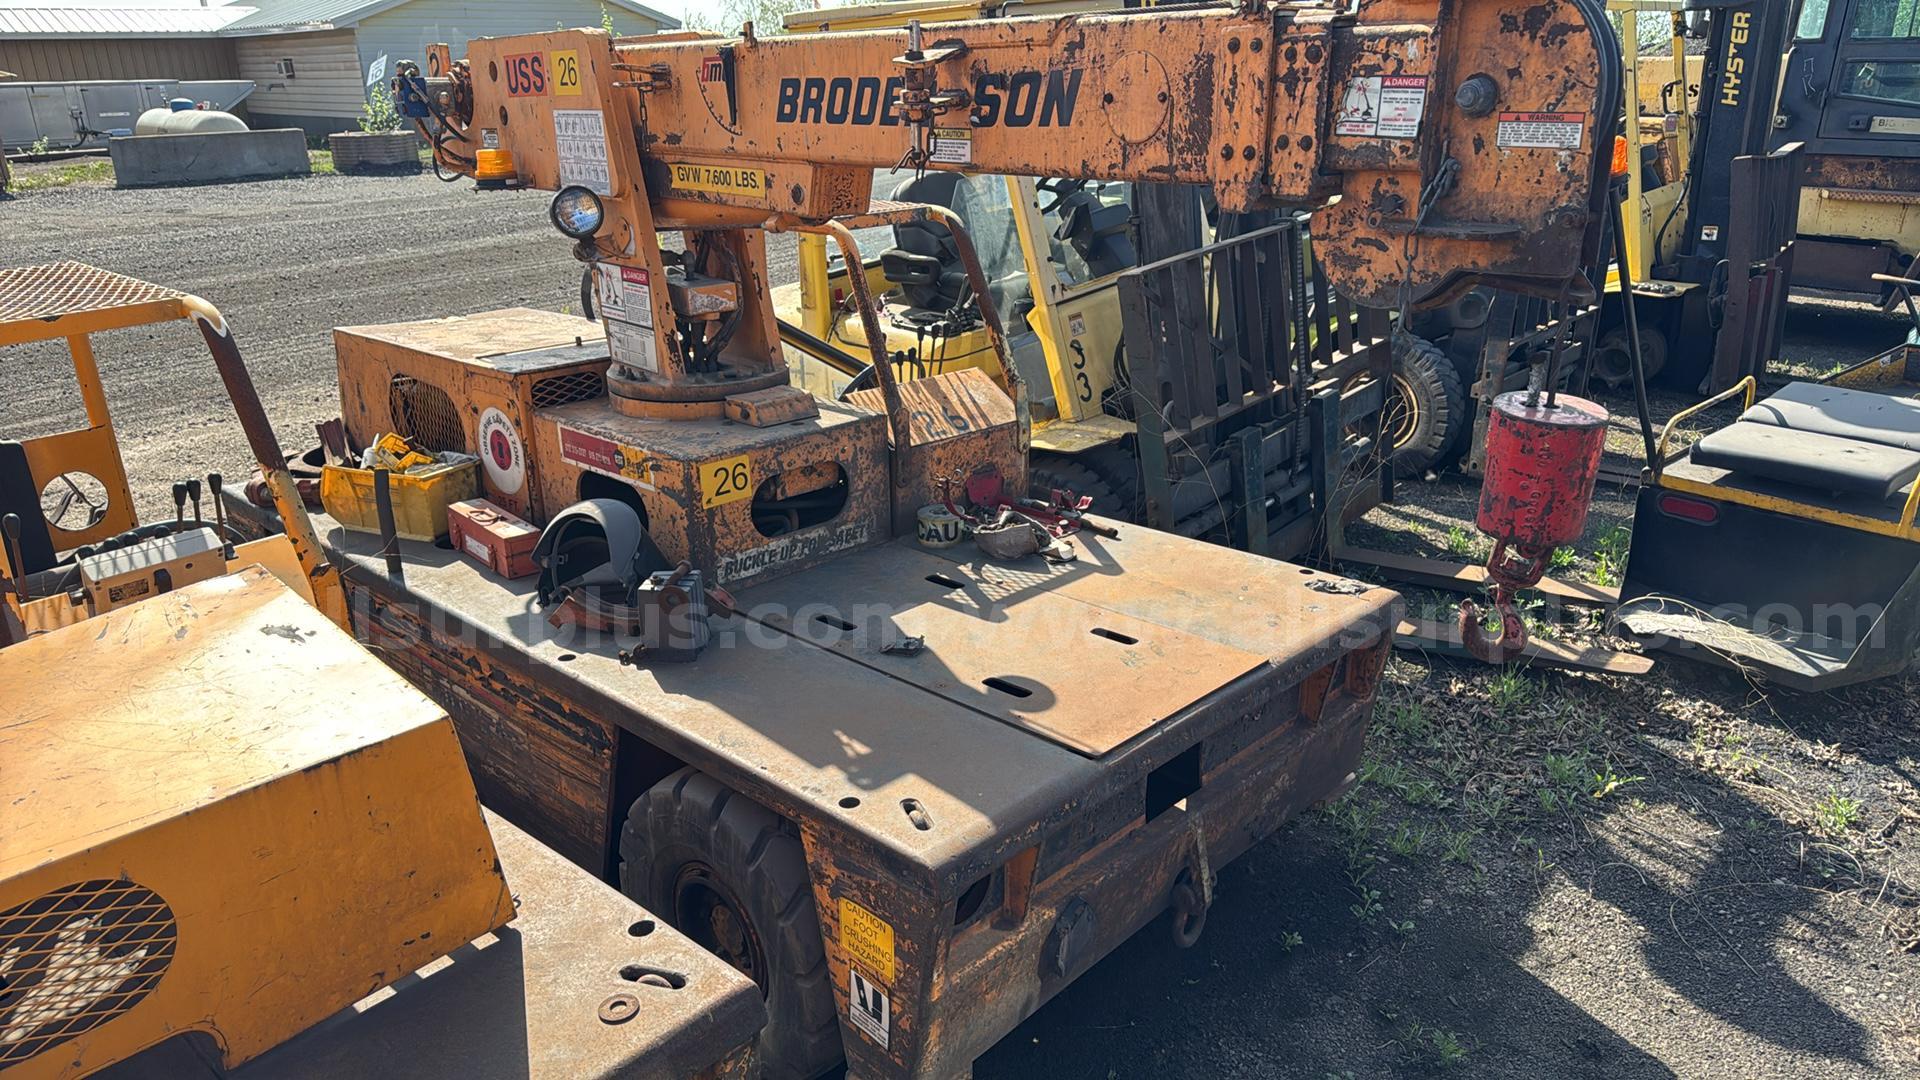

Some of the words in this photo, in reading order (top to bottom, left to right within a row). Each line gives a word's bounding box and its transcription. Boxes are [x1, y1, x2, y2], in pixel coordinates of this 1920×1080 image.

[506, 55, 545, 94] USS
[558, 56, 578, 87] 26
[1721, 12, 1751, 106] HYSTER
[1391, 78, 1425, 87] DANGER
[941, 130, 966, 138] CAUTION
[677, 166, 701, 183] GVW
[705, 169, 732, 187] 7,600
[734, 170, 760, 189] LBS.
[911, 405, 970, 437] 26
[714, 462, 749, 497] 26
[918, 519, 960, 543] CAU
[724, 550, 777, 577] BUCKLE
[780, 544, 797, 561] UP
[845, 901, 886, 934] CAUTION
[853, 918, 879, 941] FOOT
[843, 925, 893, 963] CRUSHING
[848, 941, 886, 972] HAZARD
